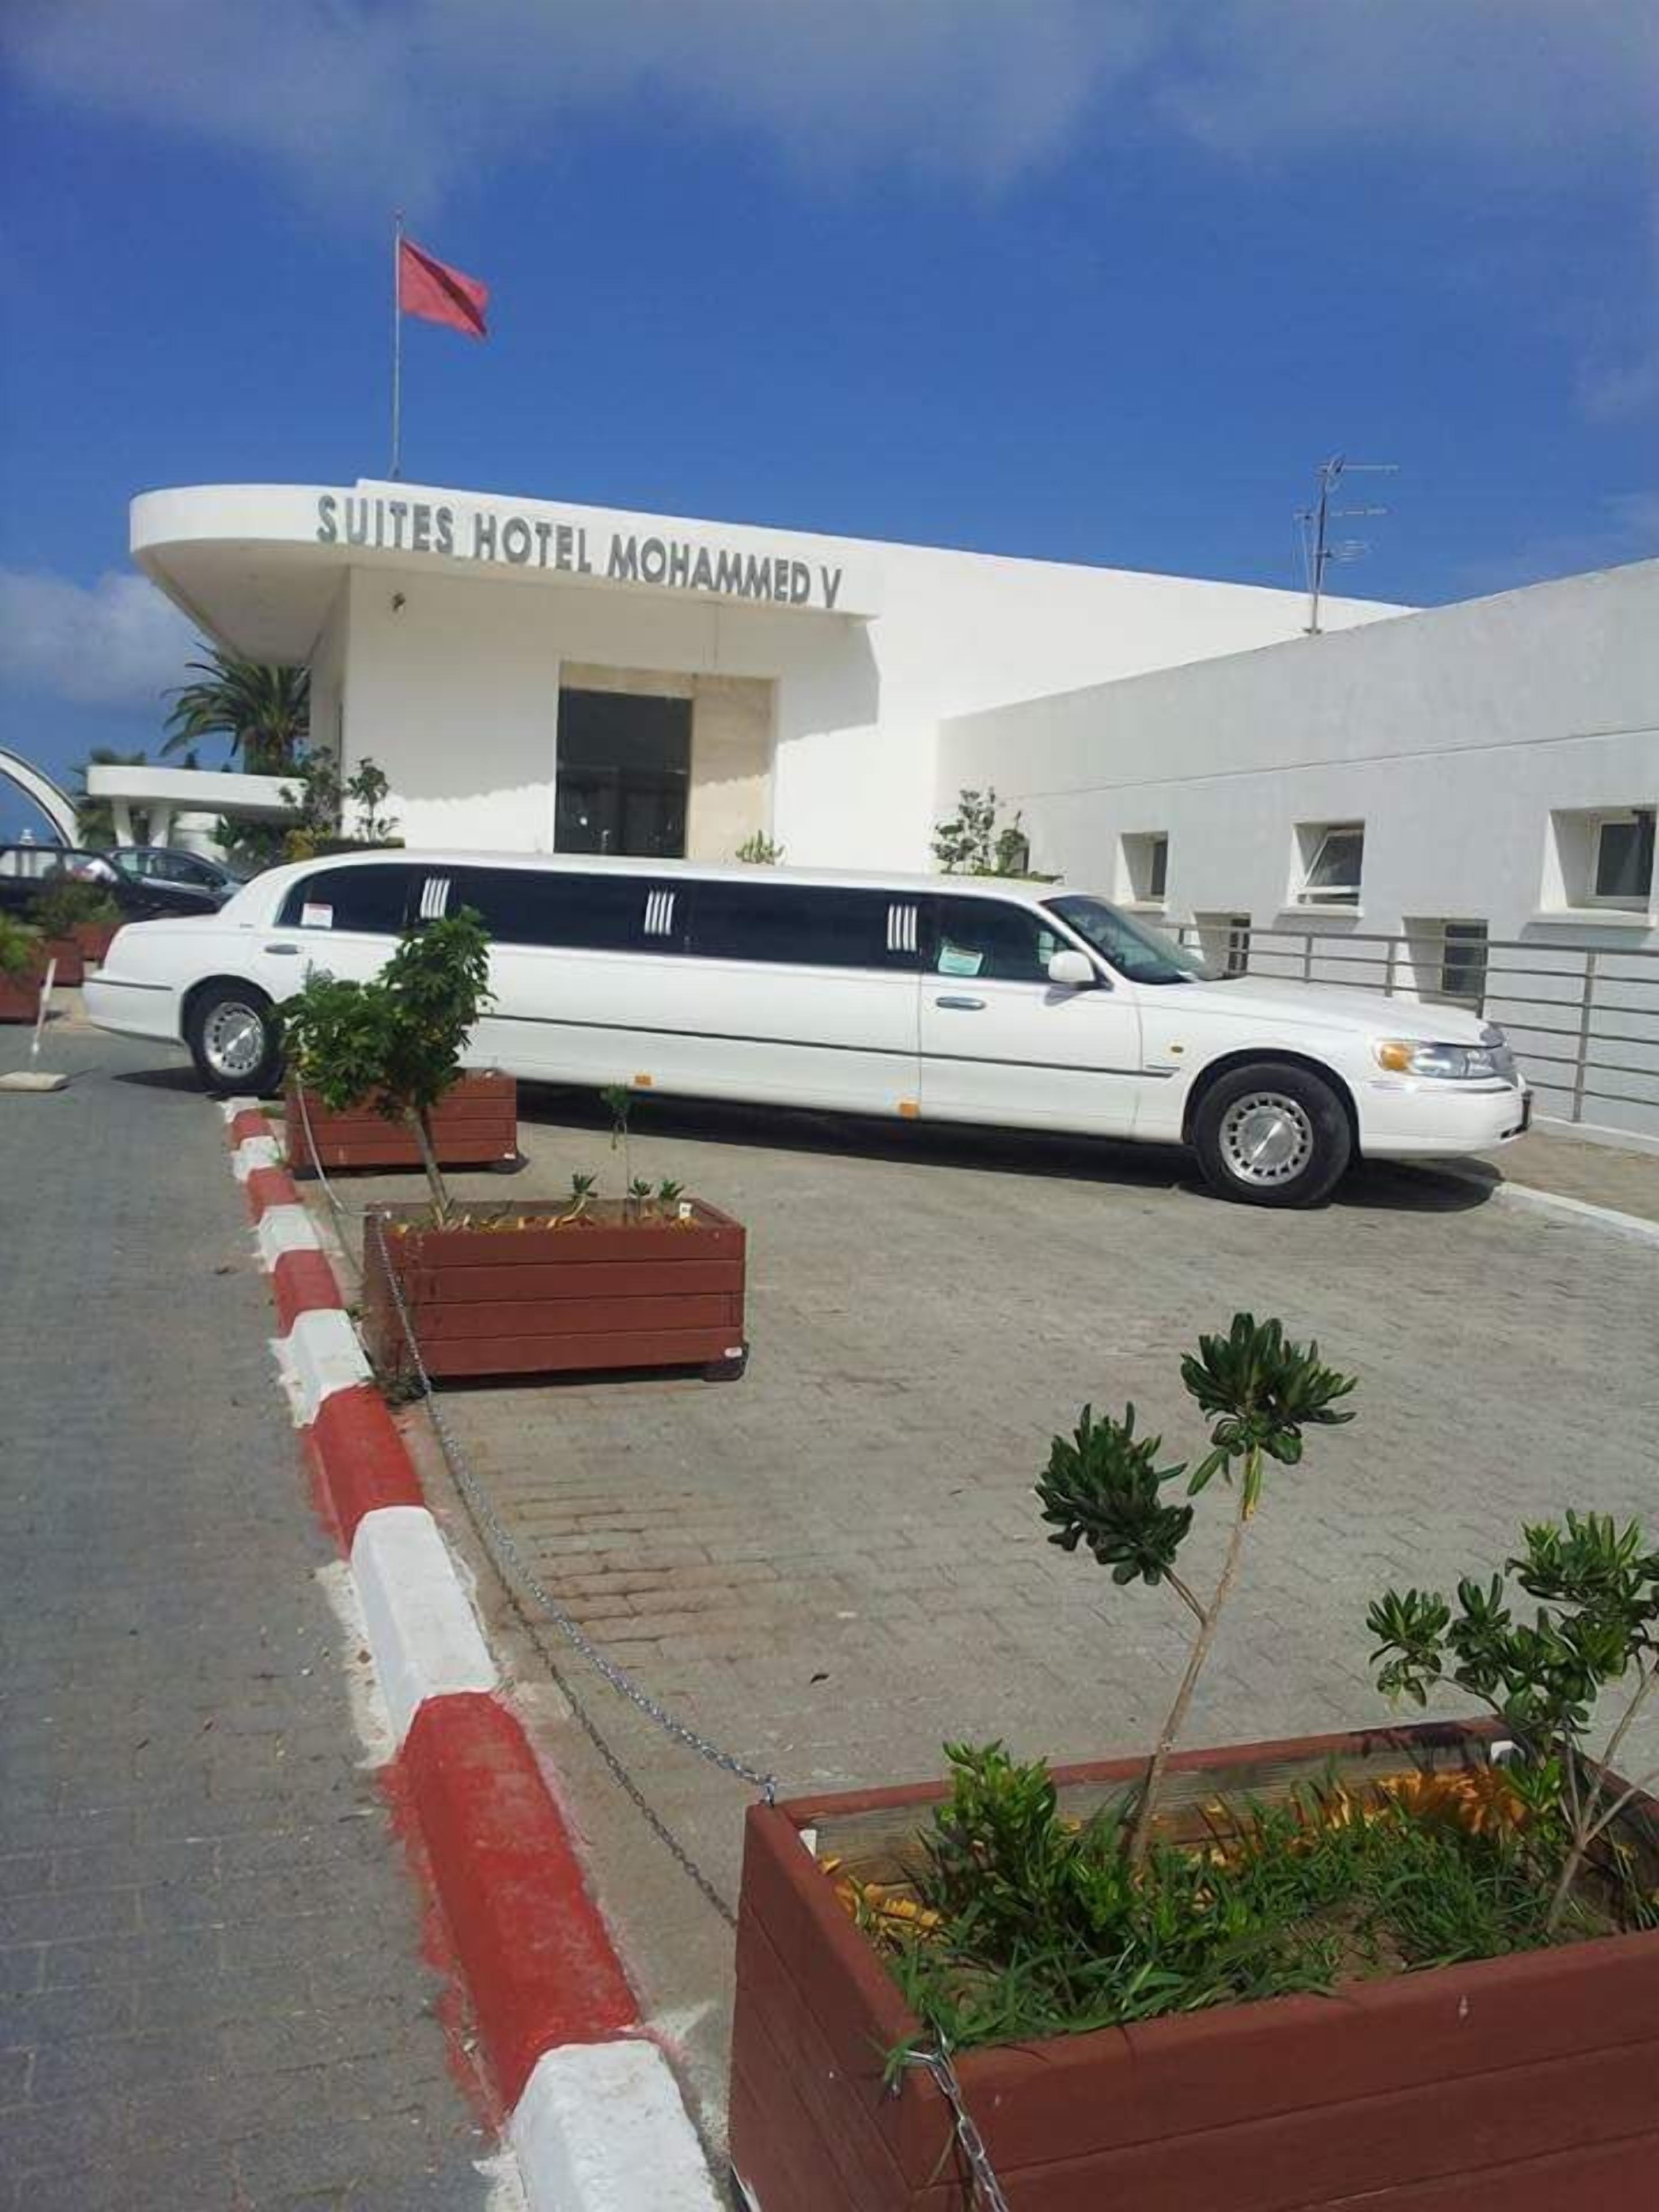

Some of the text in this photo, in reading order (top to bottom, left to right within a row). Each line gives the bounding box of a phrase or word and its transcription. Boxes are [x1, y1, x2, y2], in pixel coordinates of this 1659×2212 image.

[316, 494, 841, 608] SUITES HOTEL MOHAMMED V
